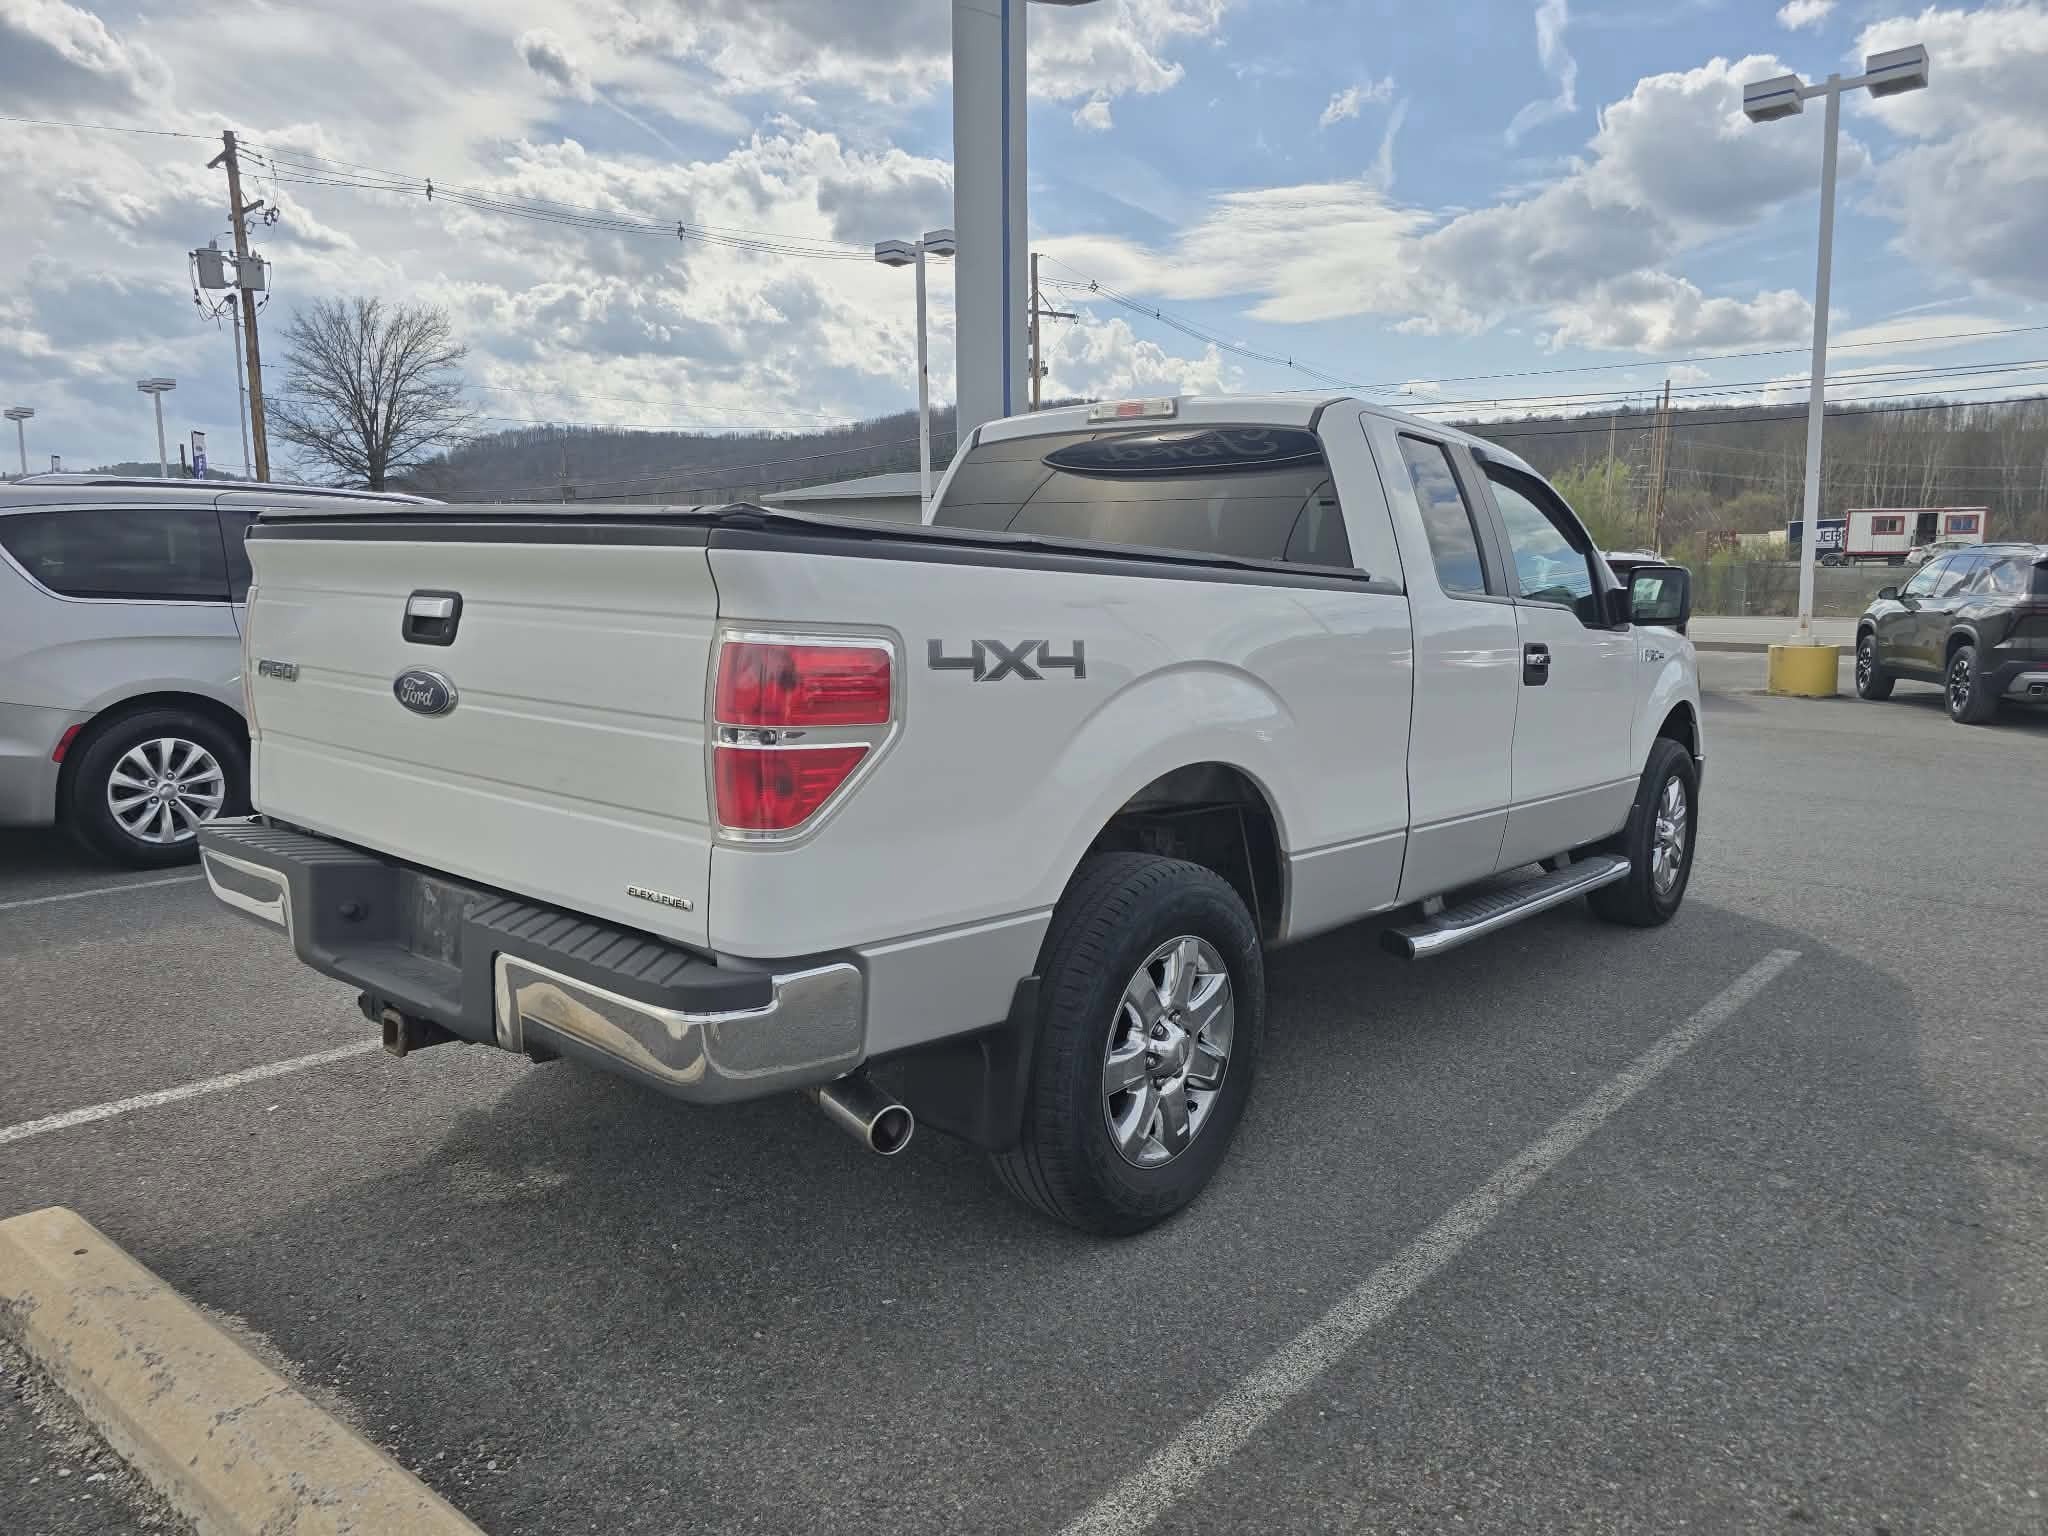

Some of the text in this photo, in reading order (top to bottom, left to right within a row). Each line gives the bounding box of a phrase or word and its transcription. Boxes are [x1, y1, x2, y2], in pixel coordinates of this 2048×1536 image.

[401, 677, 434, 706] Ford
[627, 886, 690, 911] FLEX FUEL
